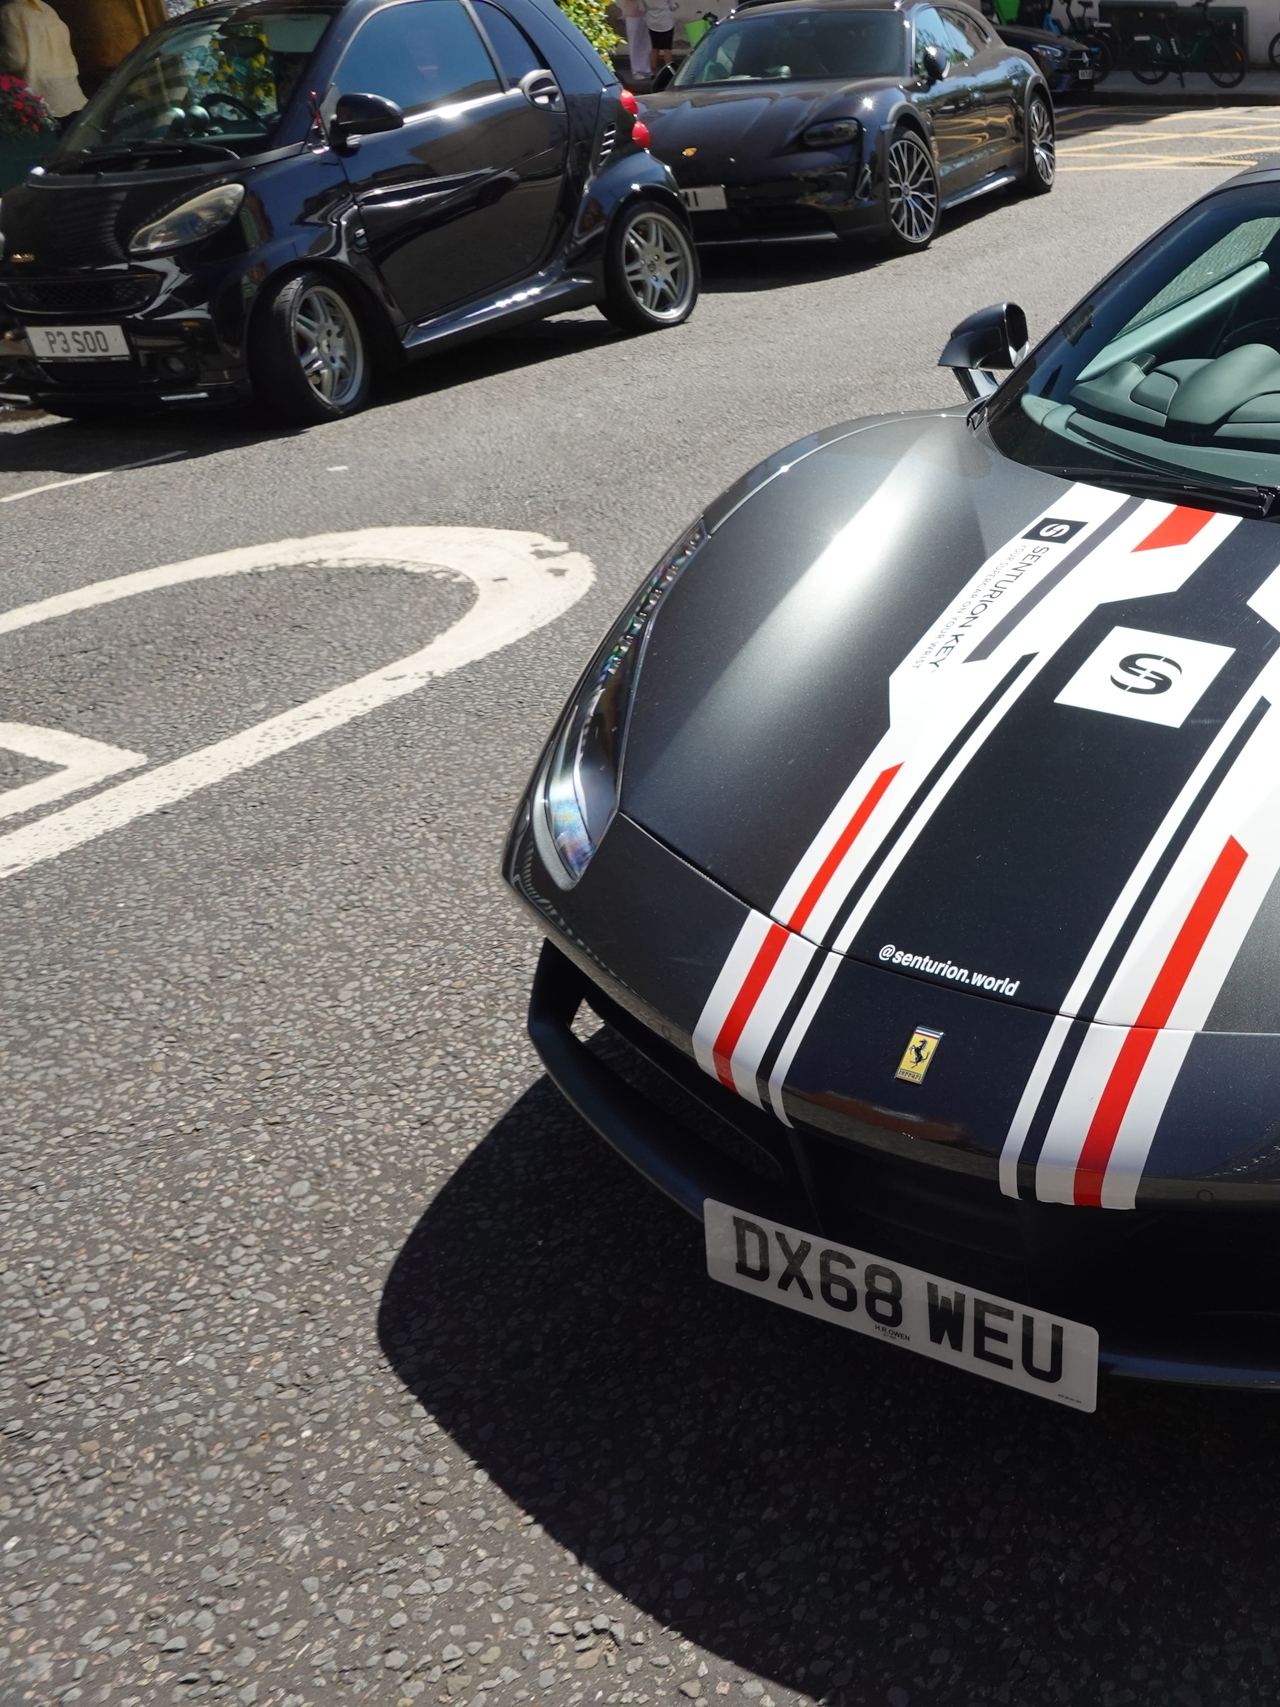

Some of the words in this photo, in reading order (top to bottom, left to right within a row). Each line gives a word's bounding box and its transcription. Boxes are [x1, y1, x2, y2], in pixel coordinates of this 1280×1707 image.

[44, 330, 71, 353] P3
[1005, 545, 1029, 561] YOUR
[958, 545, 1050, 628] SENTURION
[971, 562, 1005, 599] SUPERCAR
[957, 601, 972, 614] ON
[937, 616, 960, 640] YOUR
[912, 641, 940, 669] WRIST
[929, 633, 965, 668] KEY
[878, 944, 1020, 997] @senturion.world
[732, 1215, 903, 1329] DX68
[926, 1282, 1064, 1385] WEU
